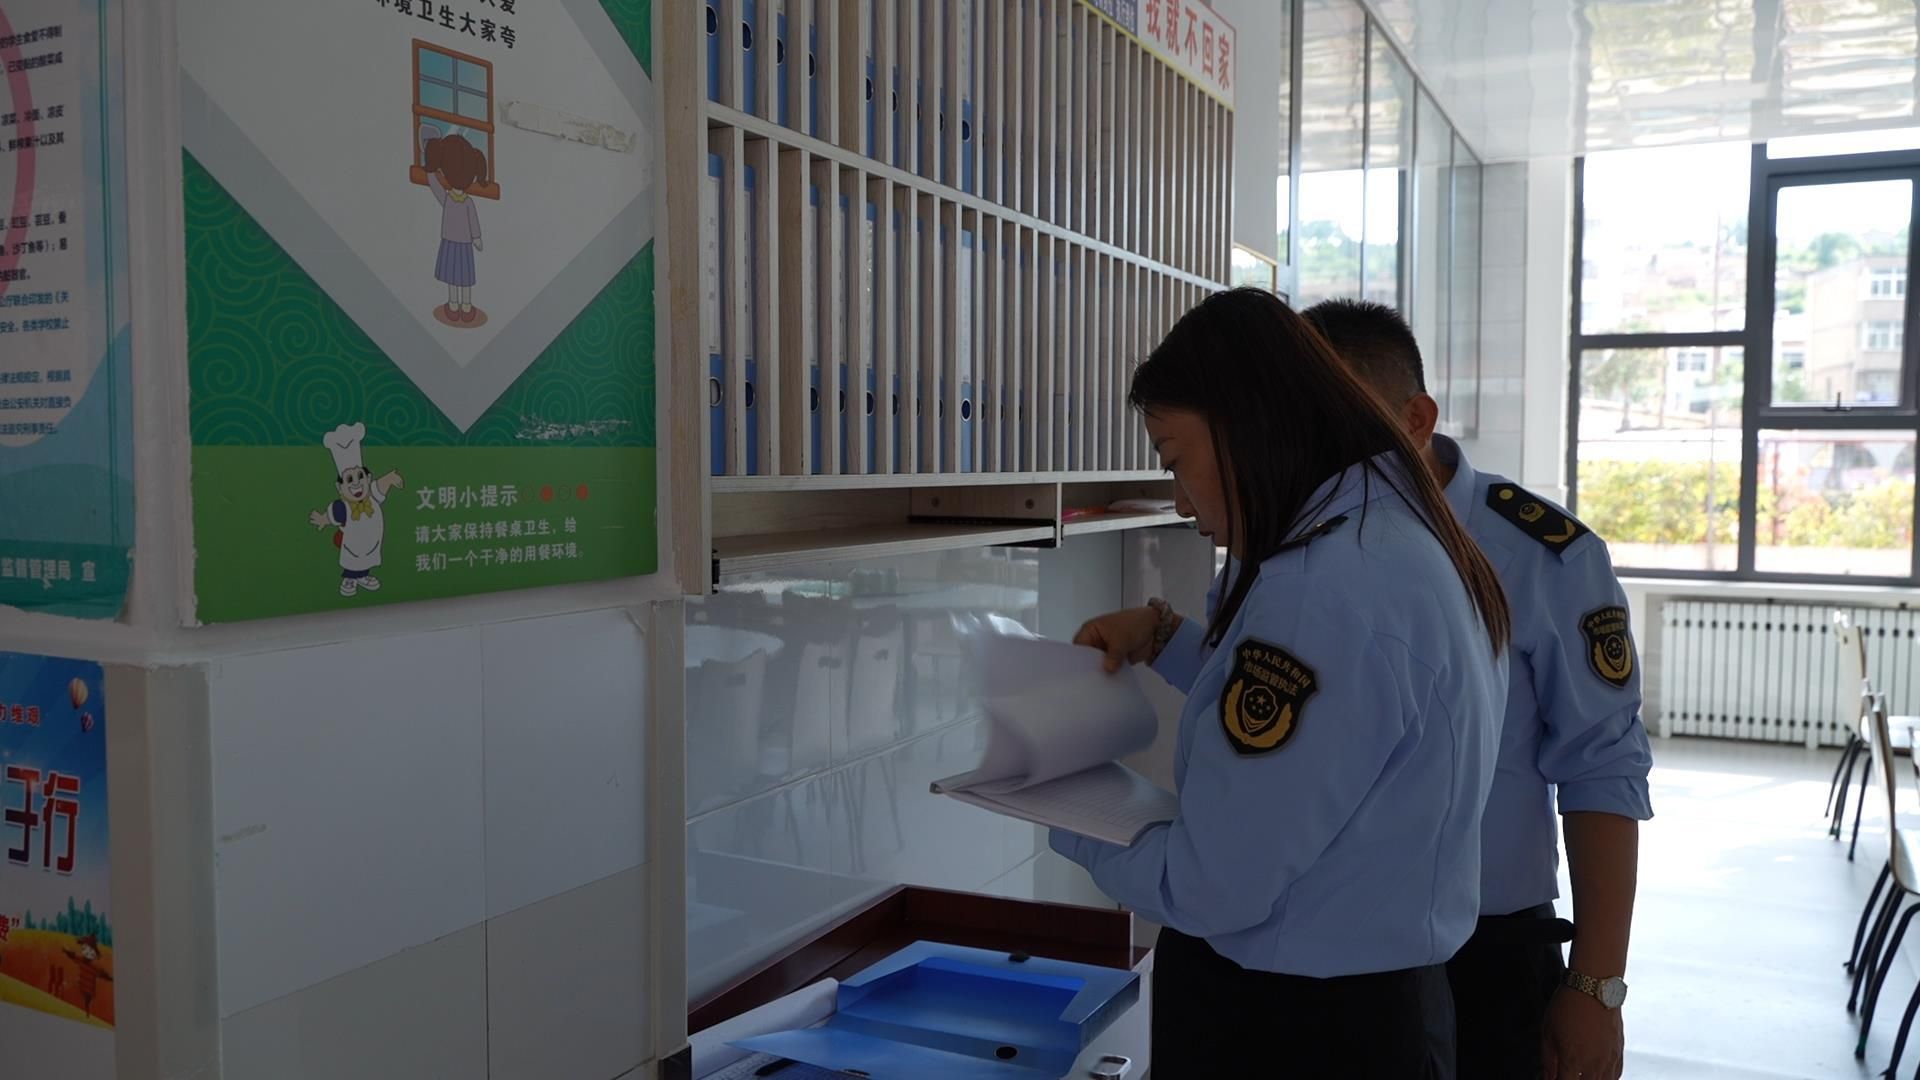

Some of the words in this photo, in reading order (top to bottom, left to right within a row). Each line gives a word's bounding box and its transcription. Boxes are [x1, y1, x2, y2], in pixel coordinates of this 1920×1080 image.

[1145, 0, 1230, 91] 我就不回家
[416, 484, 518, 511] 文明小提示
[1, 557, 71, 581] 监督管理局
[81, 560, 97, 582] 宣
[415, 542, 584, 573] 我们一个干净的用餐环境。
[1242, 648, 1312, 689] 中华人民共和国
